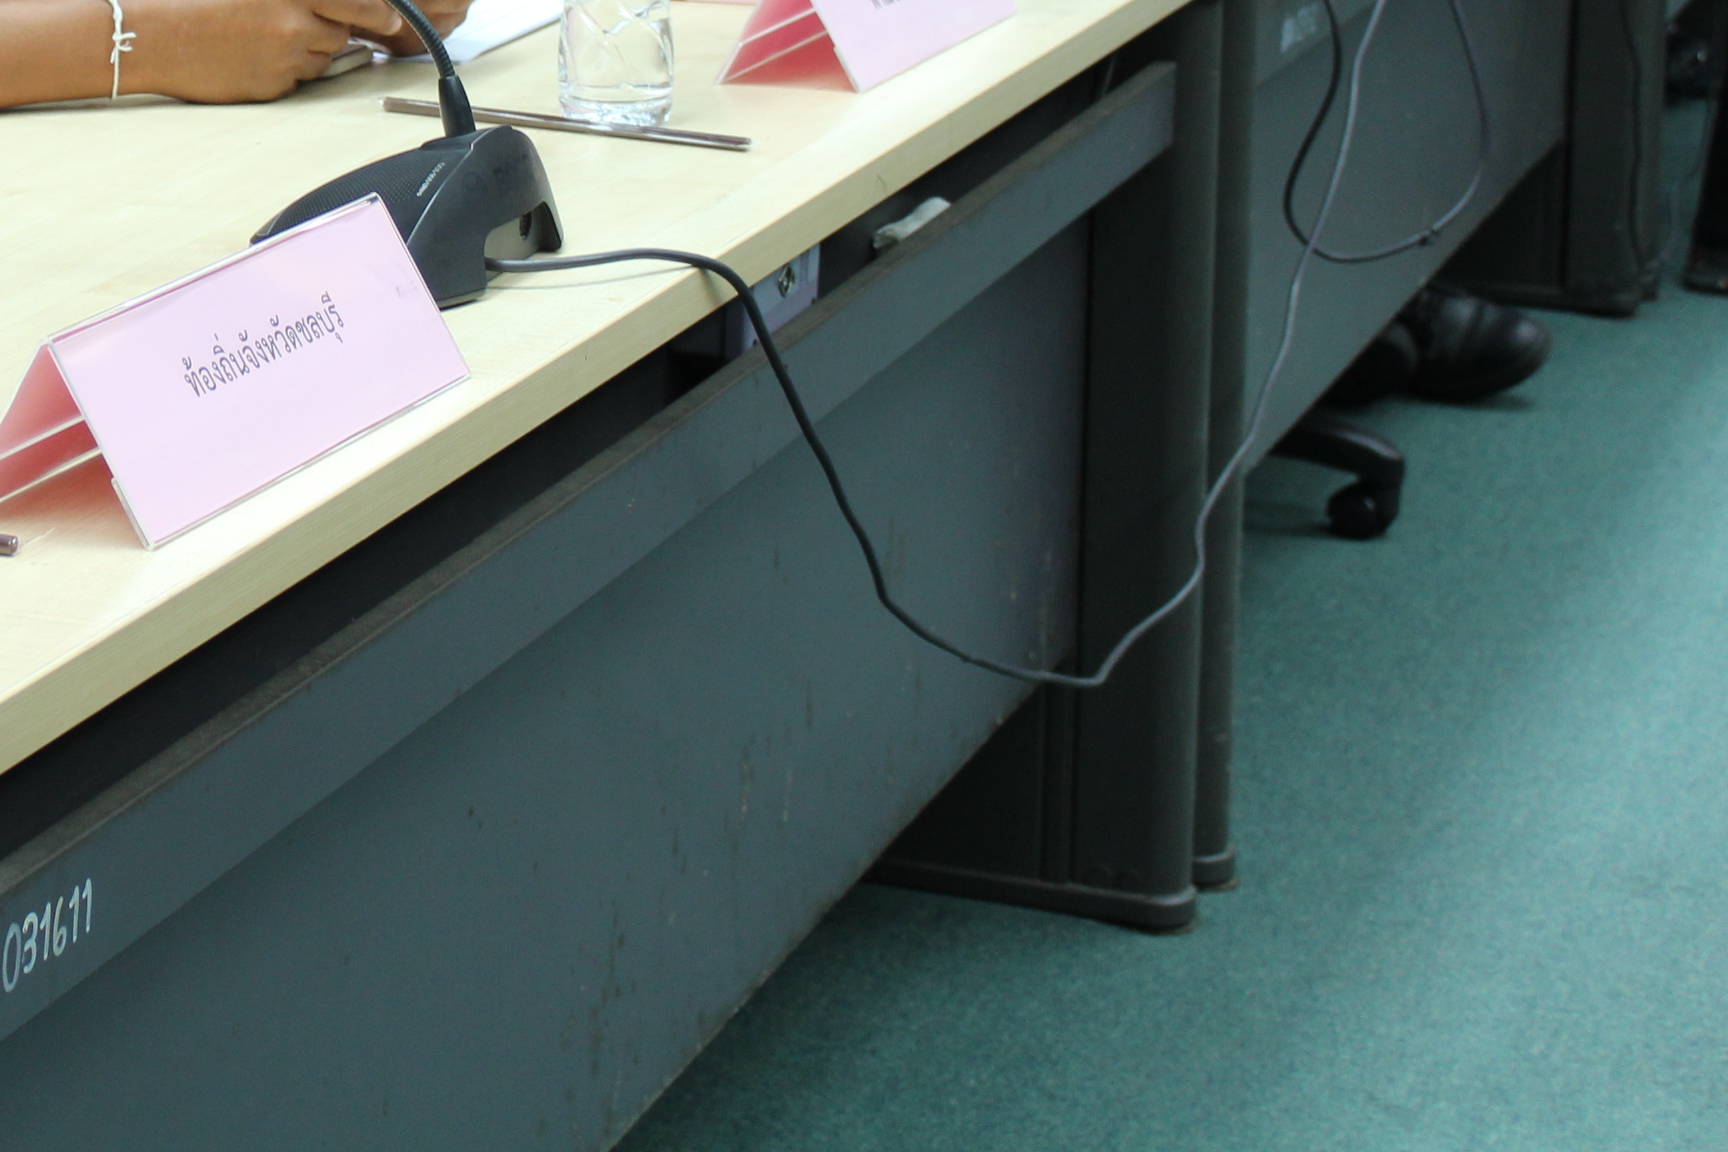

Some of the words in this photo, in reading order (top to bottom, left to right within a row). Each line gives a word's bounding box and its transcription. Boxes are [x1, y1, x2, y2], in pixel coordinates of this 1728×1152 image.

[181, 290, 345, 398] ท้องถิ่นจังหวัดชลบุรี
[2, 877, 93, 993] 031611
